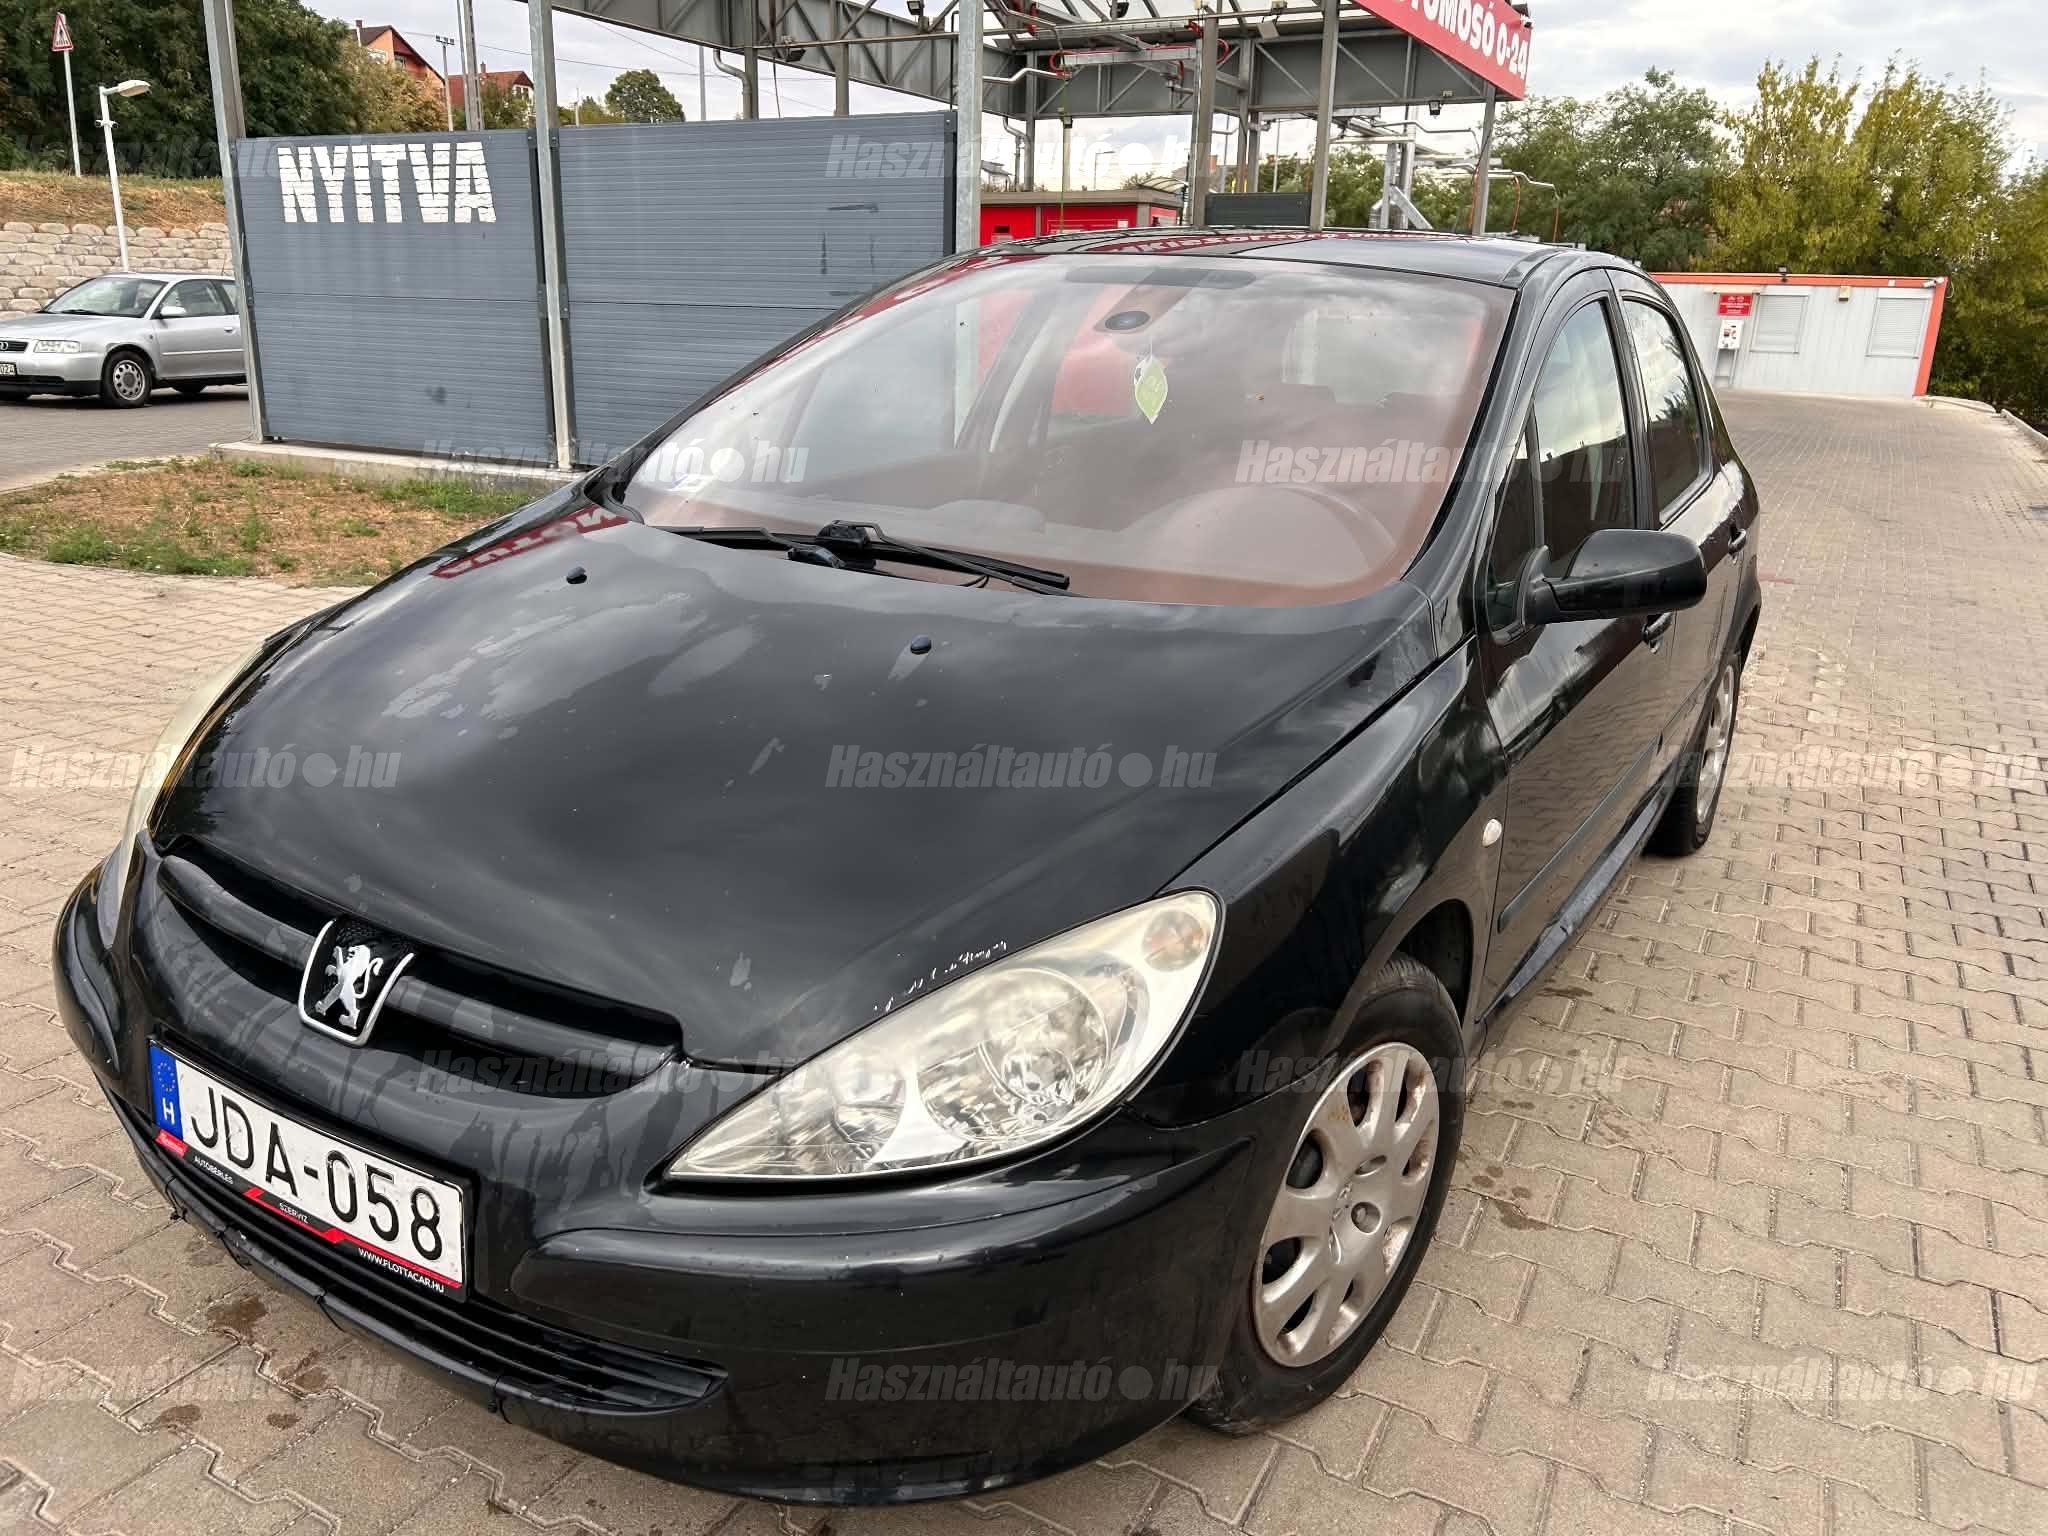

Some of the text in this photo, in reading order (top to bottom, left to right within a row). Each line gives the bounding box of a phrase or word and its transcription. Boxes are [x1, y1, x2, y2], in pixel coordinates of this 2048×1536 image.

[1411, 0, 1529, 80] OMOSÓ 0-24
[277, 141, 497, 223] NYITVA
[162, 1098, 175, 1125] H
[191, 1086, 443, 1261] JDA-058
[358, 1247, 445, 1293] WWW.FLOTTACAR.HU
